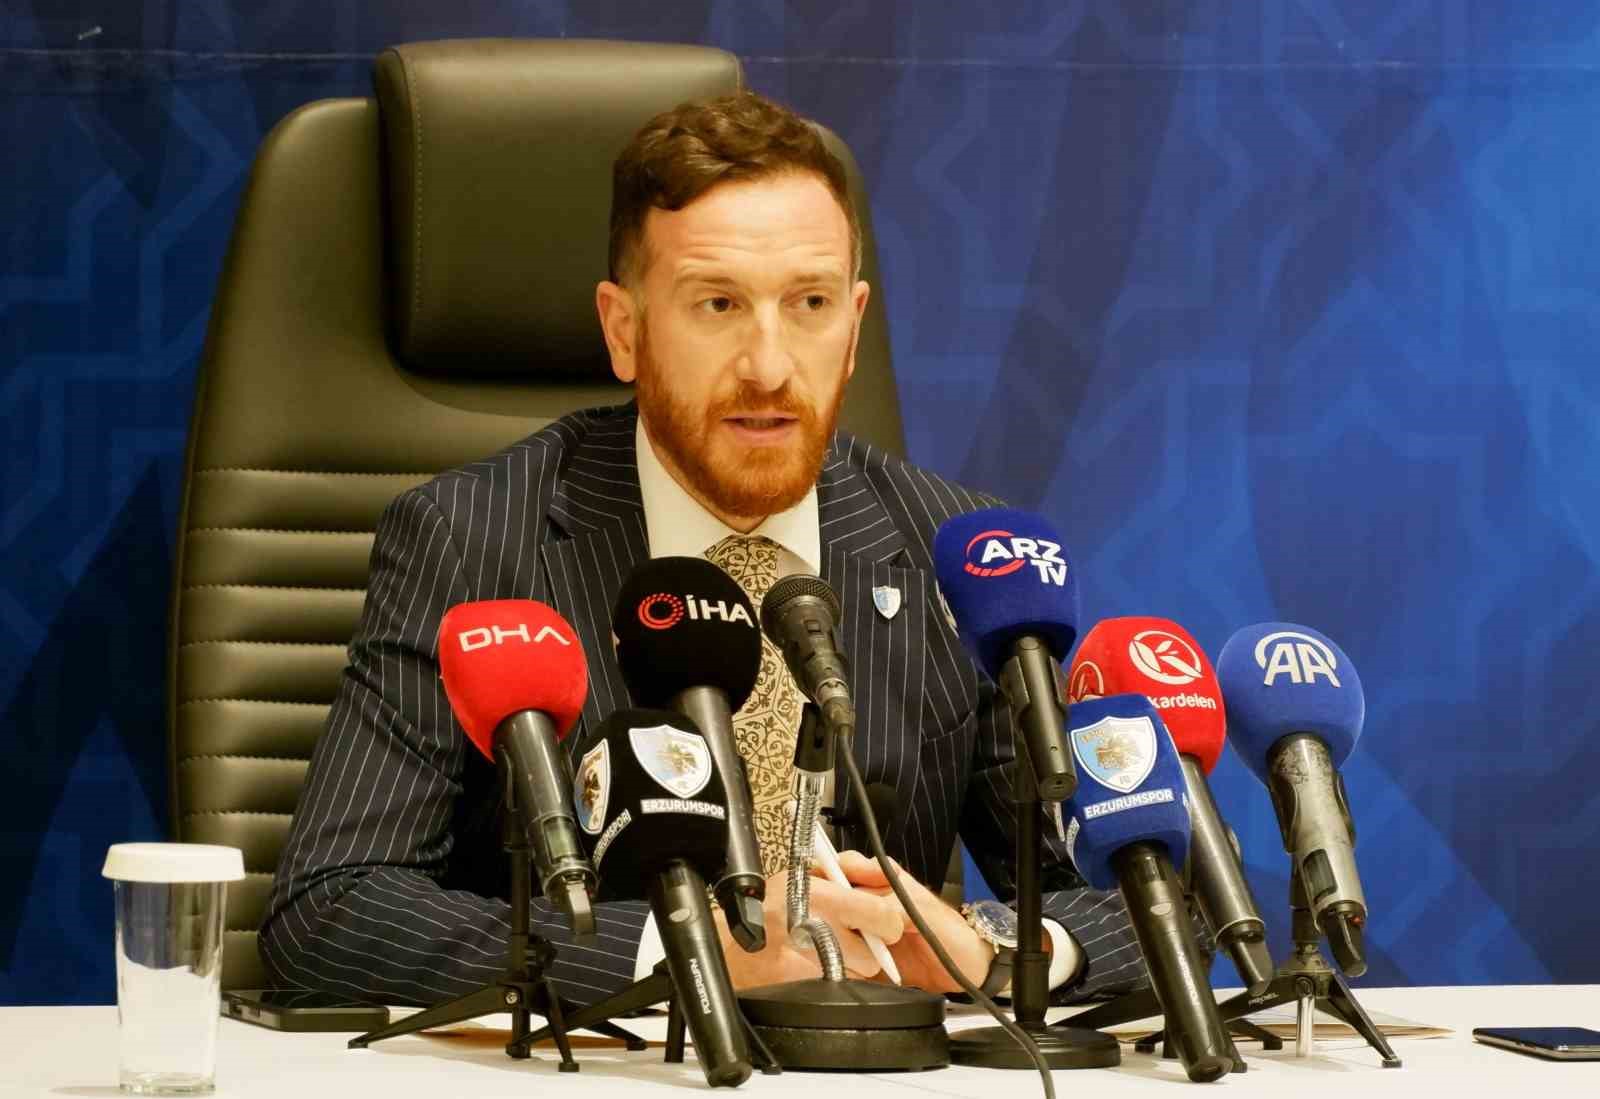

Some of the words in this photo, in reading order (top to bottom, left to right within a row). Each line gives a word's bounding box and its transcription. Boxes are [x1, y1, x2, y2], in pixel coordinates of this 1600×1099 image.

[981, 537, 1065, 563] ARZ
[1031, 559, 1068, 586] TV
[686, 595, 754, 628] İHA
[458, 624, 571, 652] DHA
[1263, 643, 1341, 687] AA
[642, 800, 725, 818] ERZURUMSPOR
[1085, 789, 1174, 818] ERZURUMSPOR
